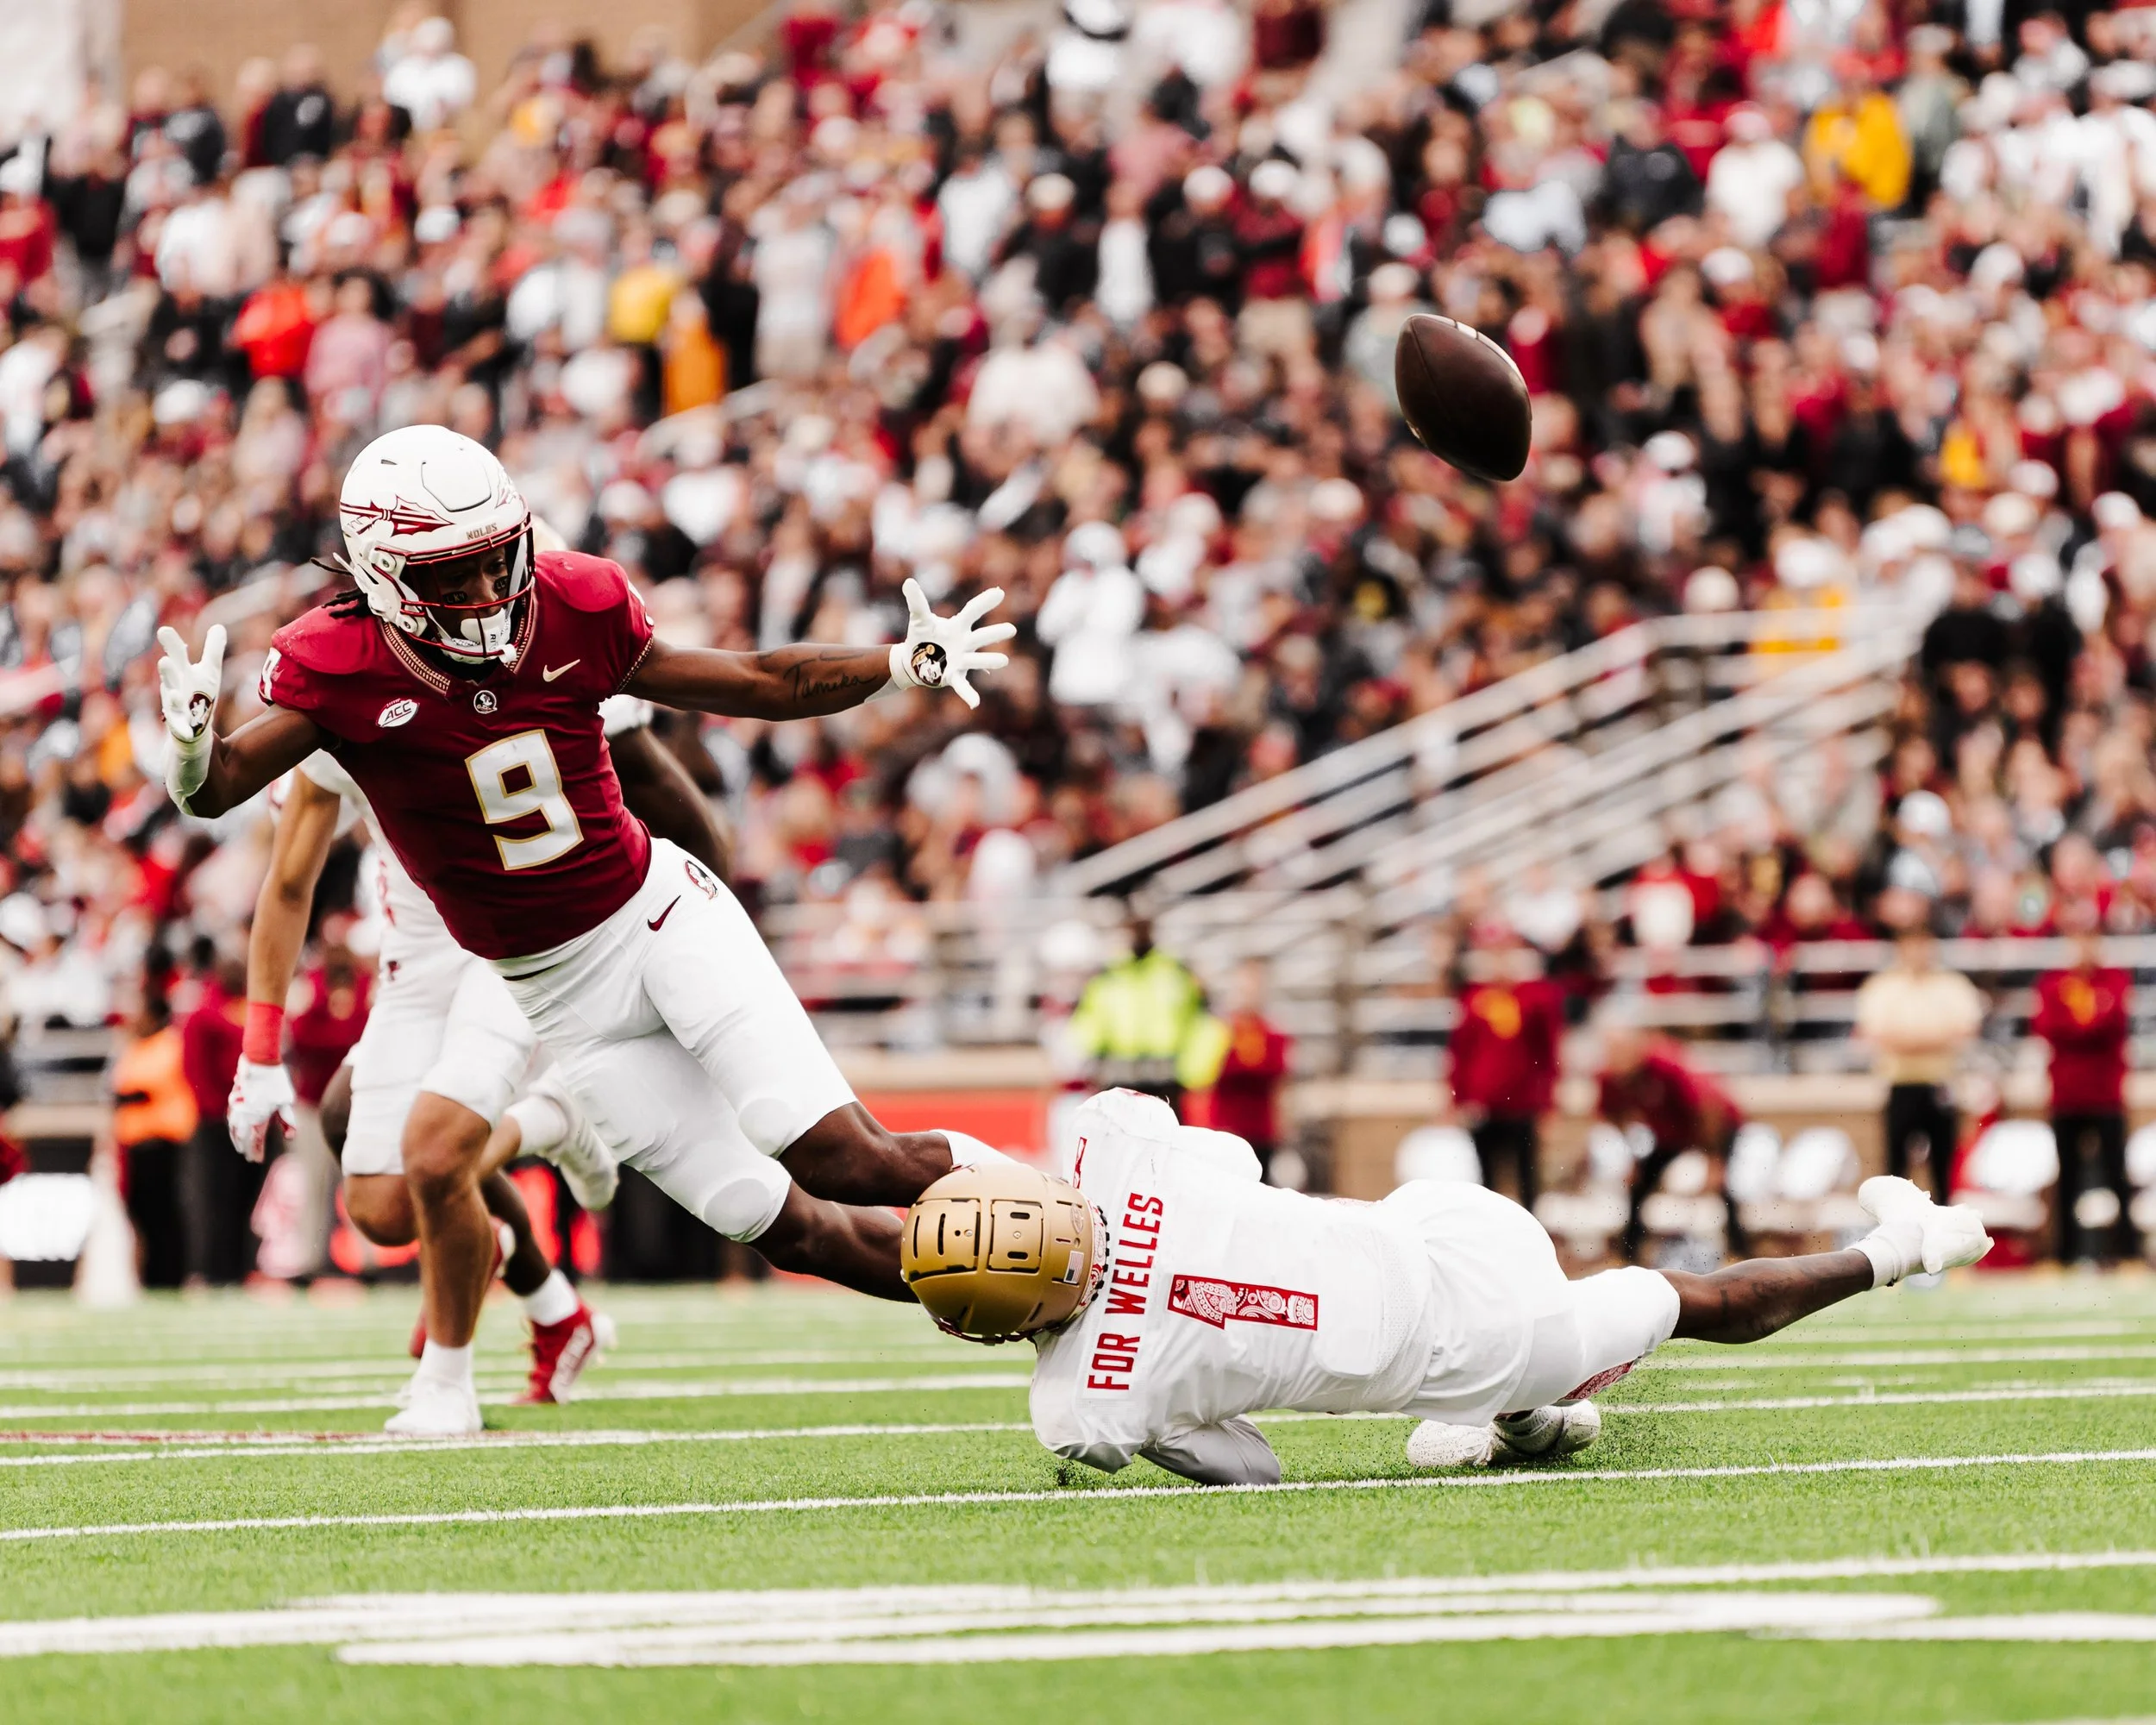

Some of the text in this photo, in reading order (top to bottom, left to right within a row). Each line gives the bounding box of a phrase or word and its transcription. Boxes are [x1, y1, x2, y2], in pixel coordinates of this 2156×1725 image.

[385, 701, 412, 722] ACC
[464, 729, 585, 871] 9
[1087, 1192, 1164, 1390] FOR WELLES
[1168, 1274, 1319, 1331] 1
